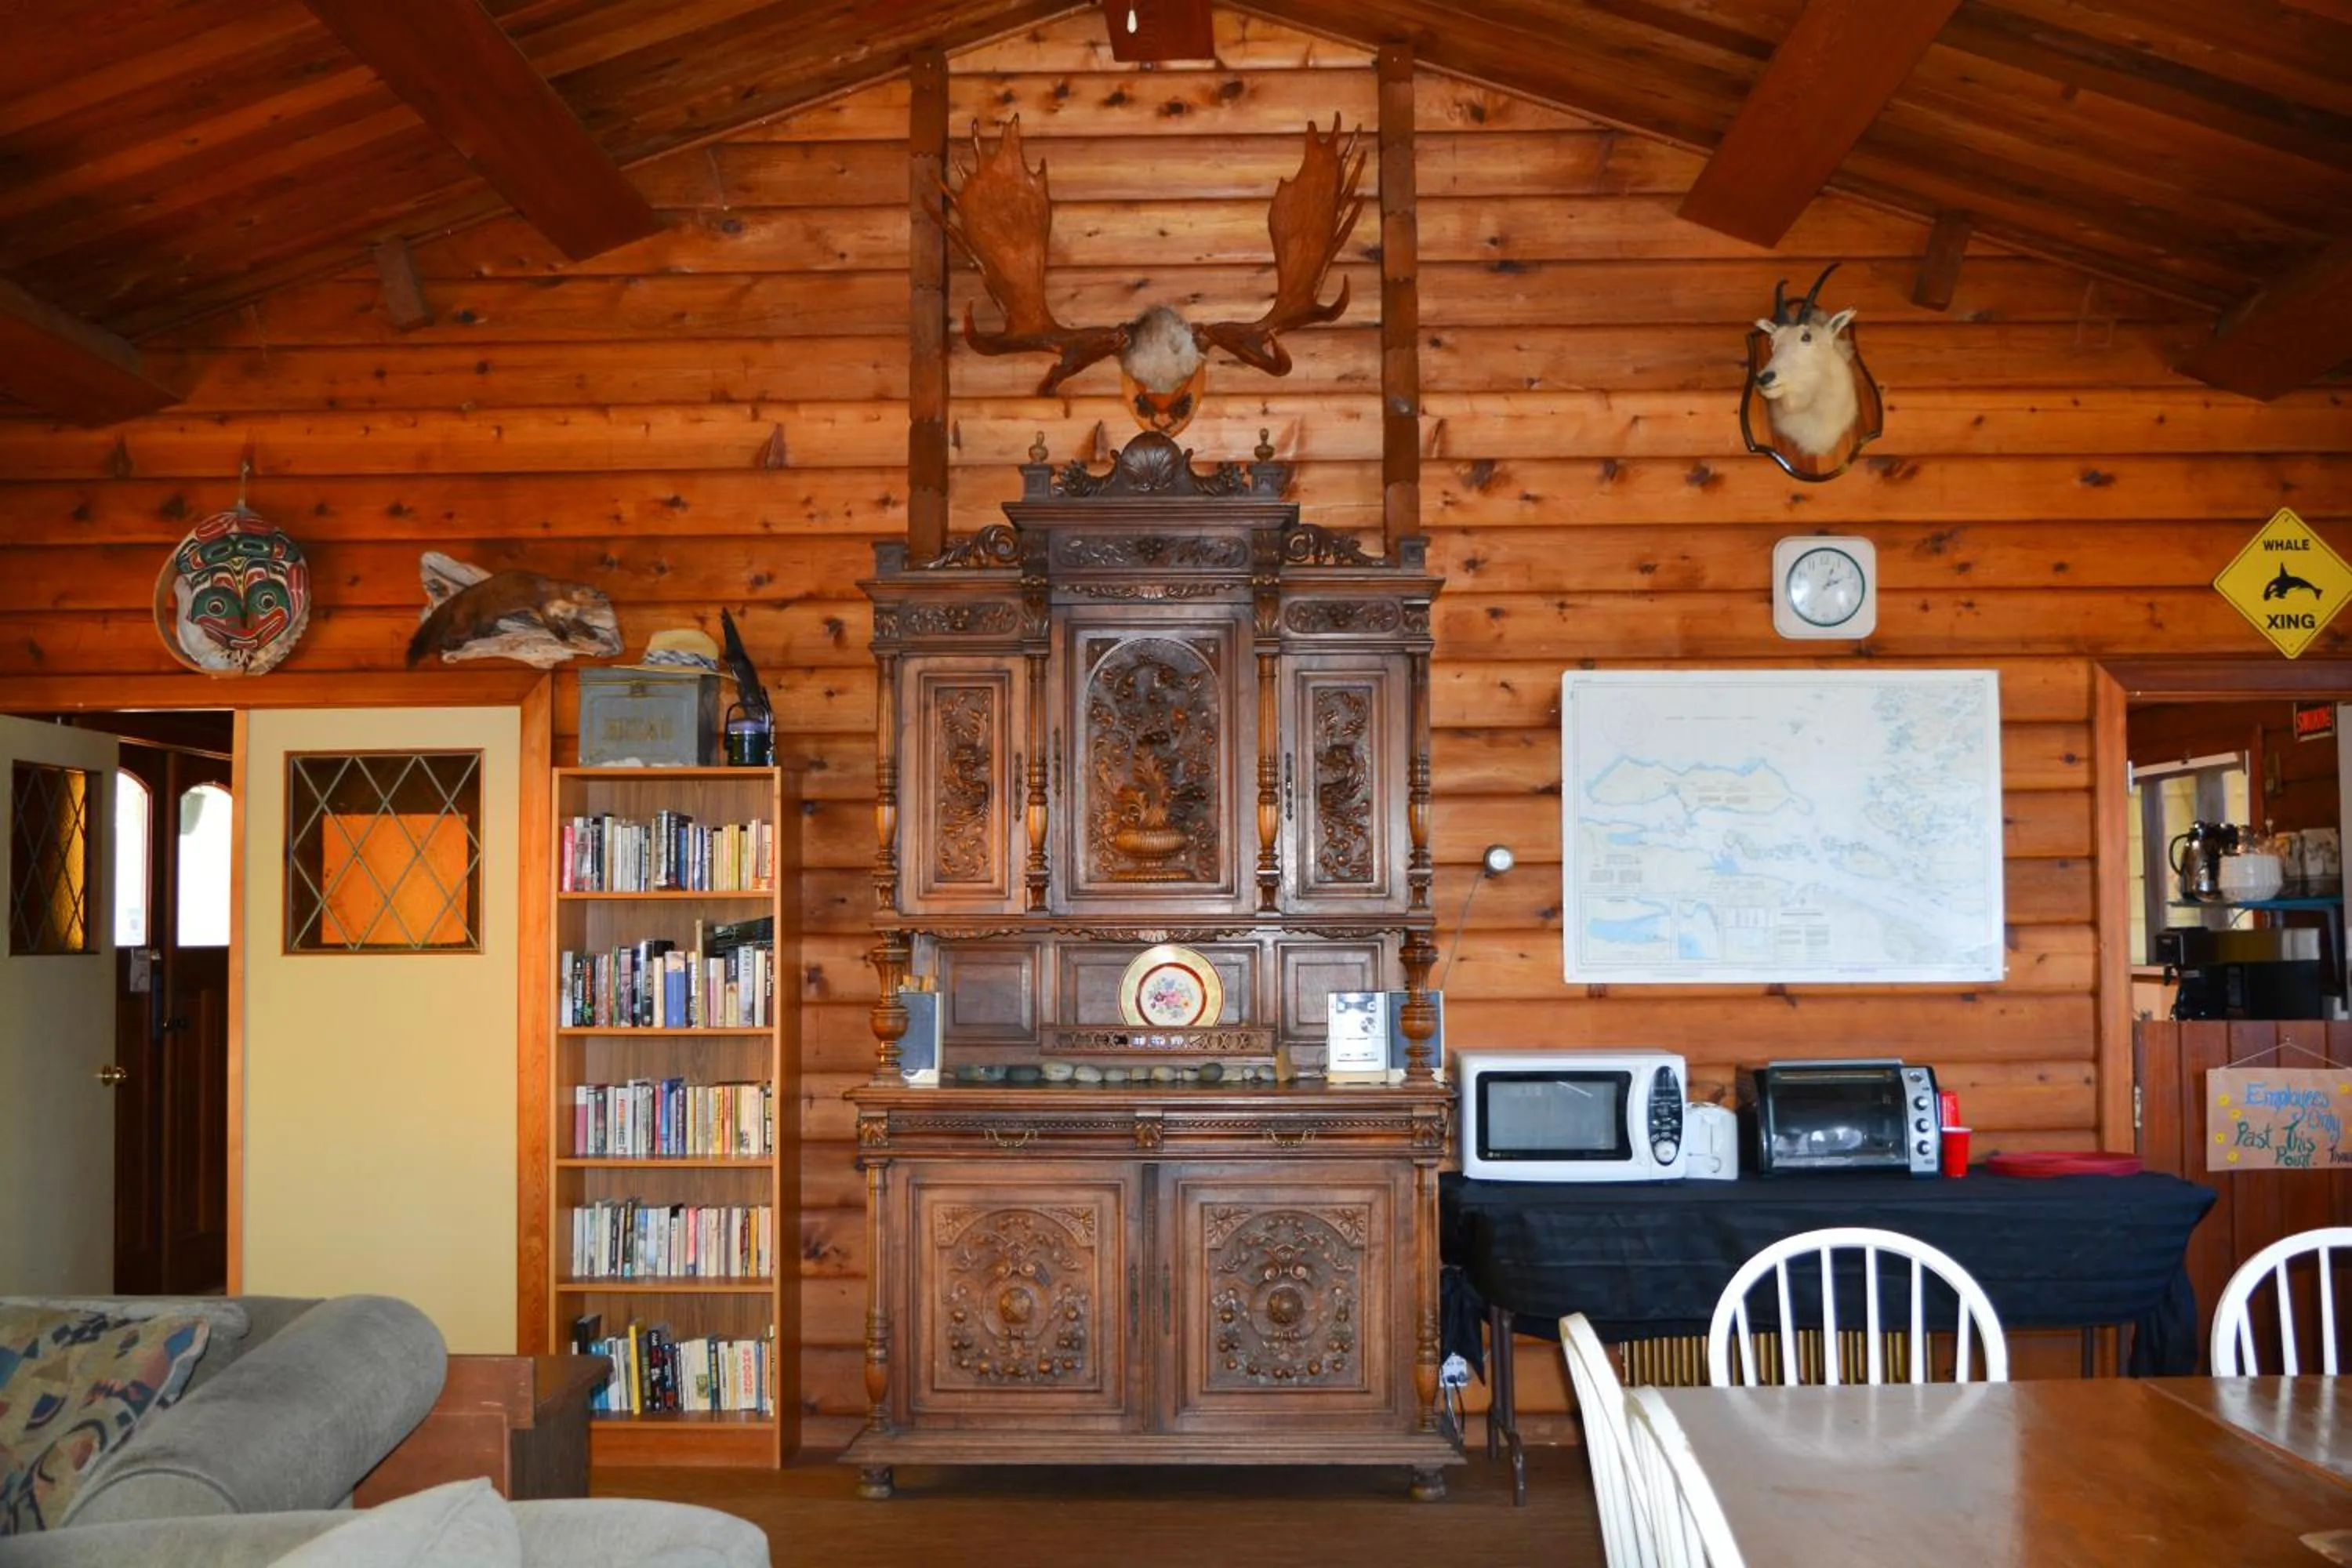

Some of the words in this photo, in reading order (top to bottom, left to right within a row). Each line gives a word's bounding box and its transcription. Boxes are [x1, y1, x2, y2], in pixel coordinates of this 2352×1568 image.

[2263, 539, 2310, 551] WHALE
[2266, 614, 2316, 630] XING
[2234, 1120, 2272, 1149] Past
[2281, 1120, 2316, 1152] This
